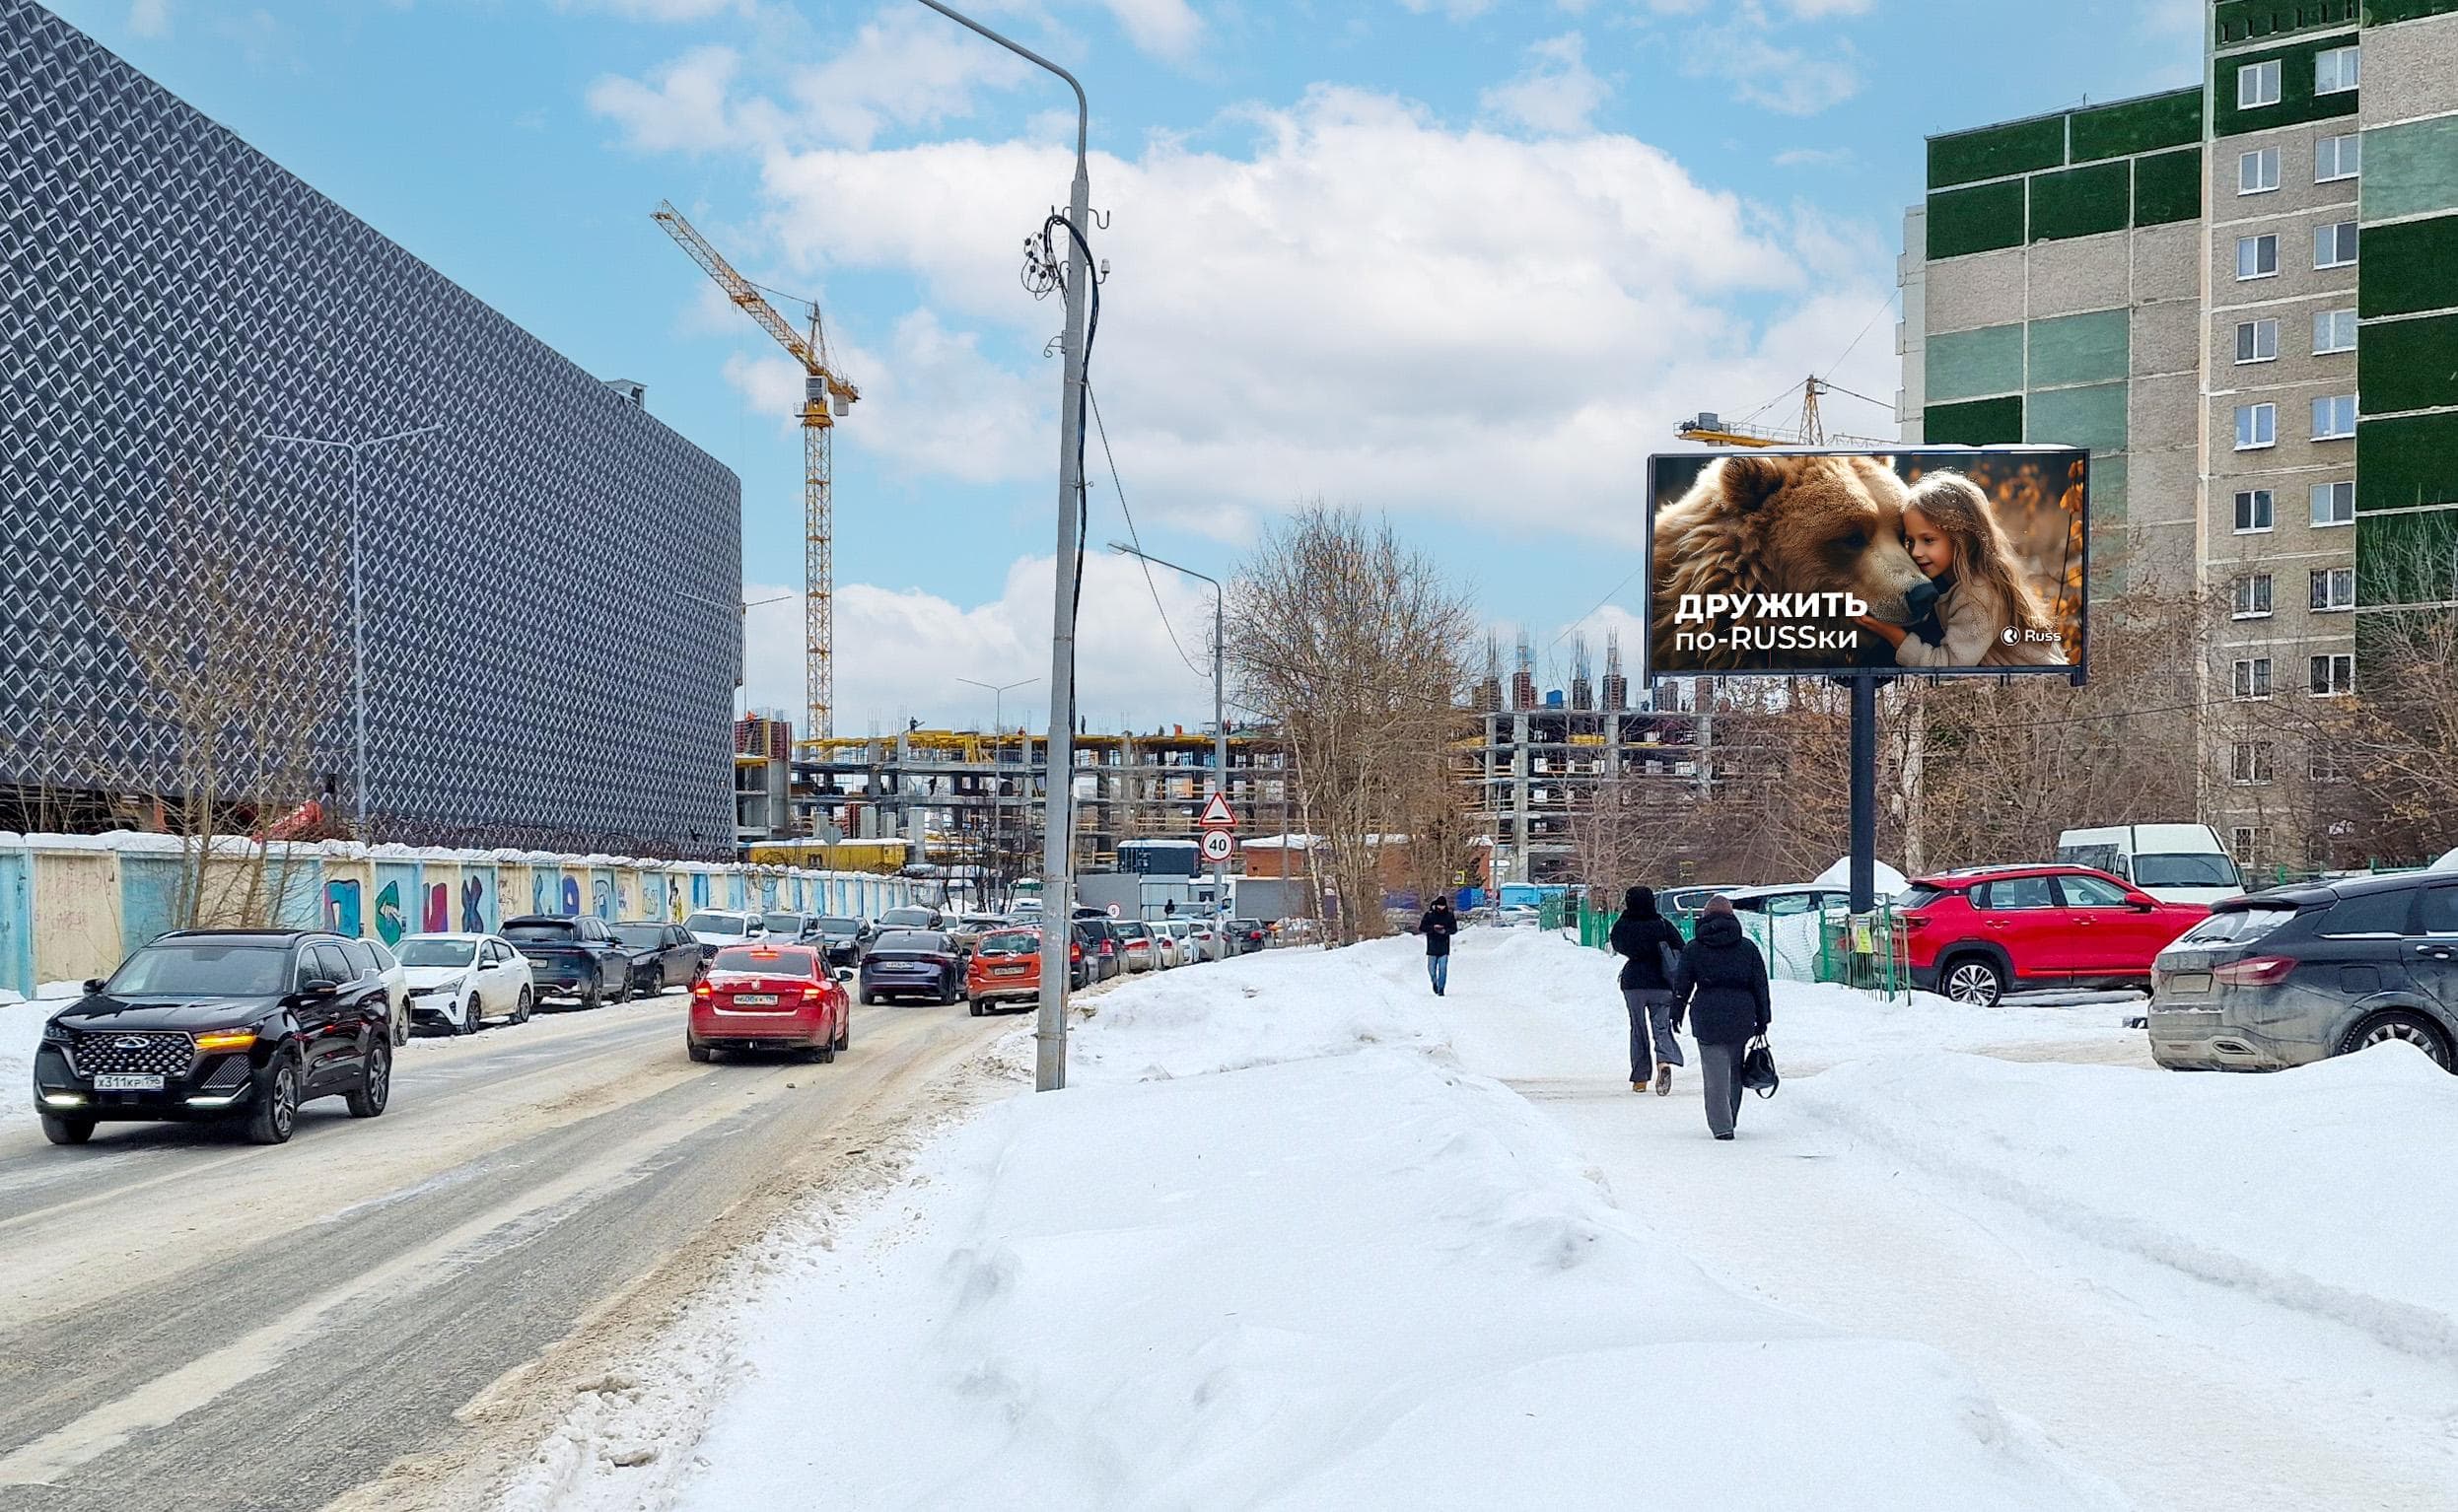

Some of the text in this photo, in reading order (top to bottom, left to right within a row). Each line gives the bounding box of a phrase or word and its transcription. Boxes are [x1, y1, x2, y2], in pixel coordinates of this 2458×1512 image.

[1674, 591, 1868, 624] ДРУЖИТЬ
[1676, 625, 1858, 652] по-RUSSки
[2024, 629, 2062, 642] Russ
[1209, 839, 1227, 852] 40
